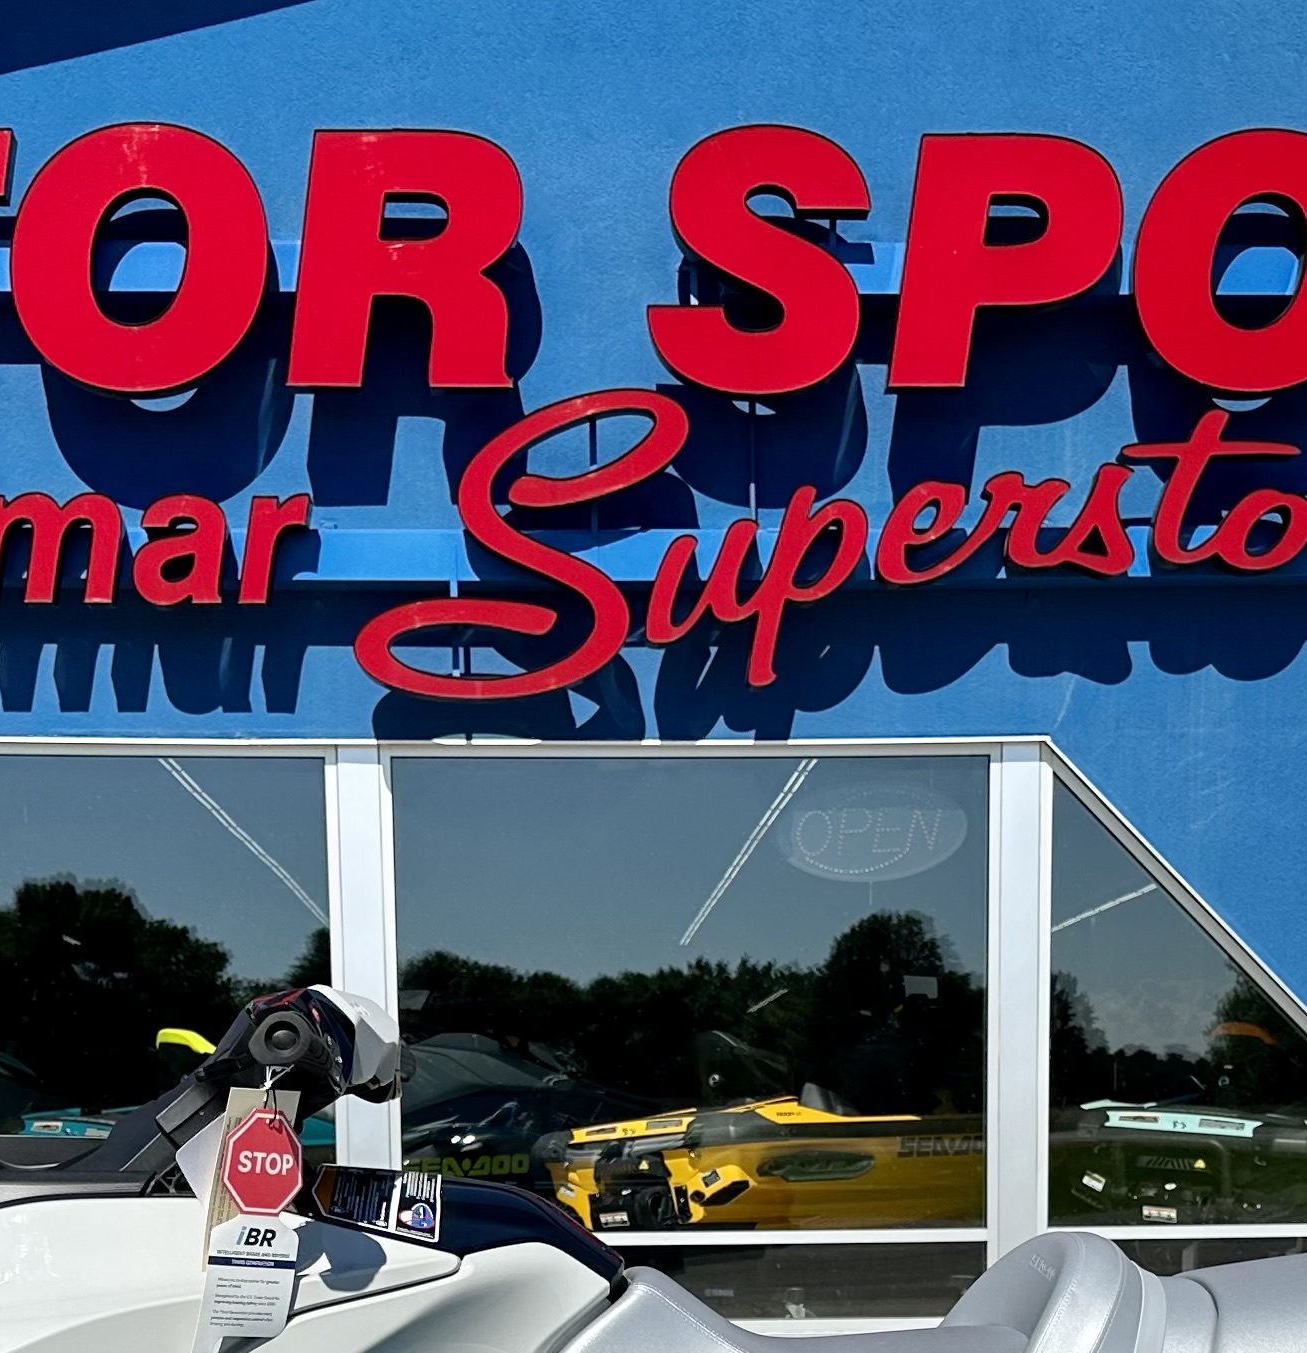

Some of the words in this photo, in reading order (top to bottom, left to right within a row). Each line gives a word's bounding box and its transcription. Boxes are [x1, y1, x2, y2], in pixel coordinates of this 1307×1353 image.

[796, 808, 943, 857] OPEN
[237, 1150, 294, 1176] STOP
[236, 1226, 277, 1247] iBR
